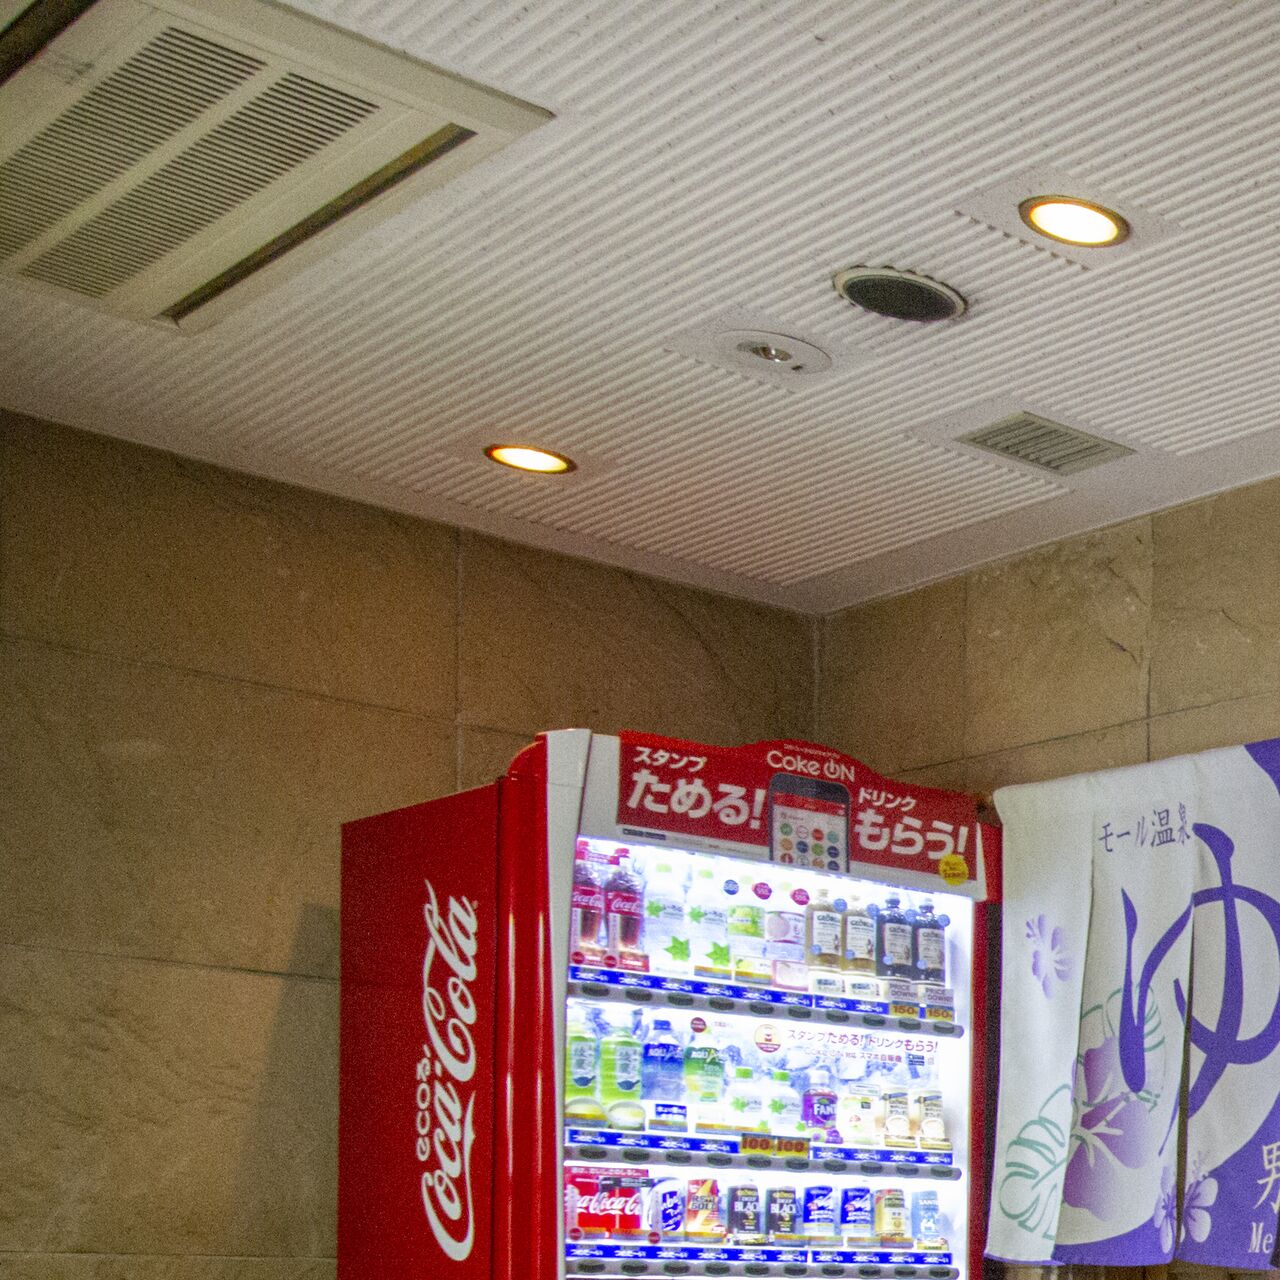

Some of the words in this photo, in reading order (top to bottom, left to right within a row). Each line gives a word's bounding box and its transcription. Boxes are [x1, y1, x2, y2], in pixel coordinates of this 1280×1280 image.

[633, 746, 707, 772] スタンプ
[766, 750, 820, 777] Coke
[626, 768, 767, 830] ためる!
[858, 787, 917, 812] ドリンク
[855, 808, 969, 861] もらう!
[1099, 801, 1194, 854] モール温泉
[421, 879, 478, 1262] Coca-Cola
[1248, 1222, 1274, 1254] Me
